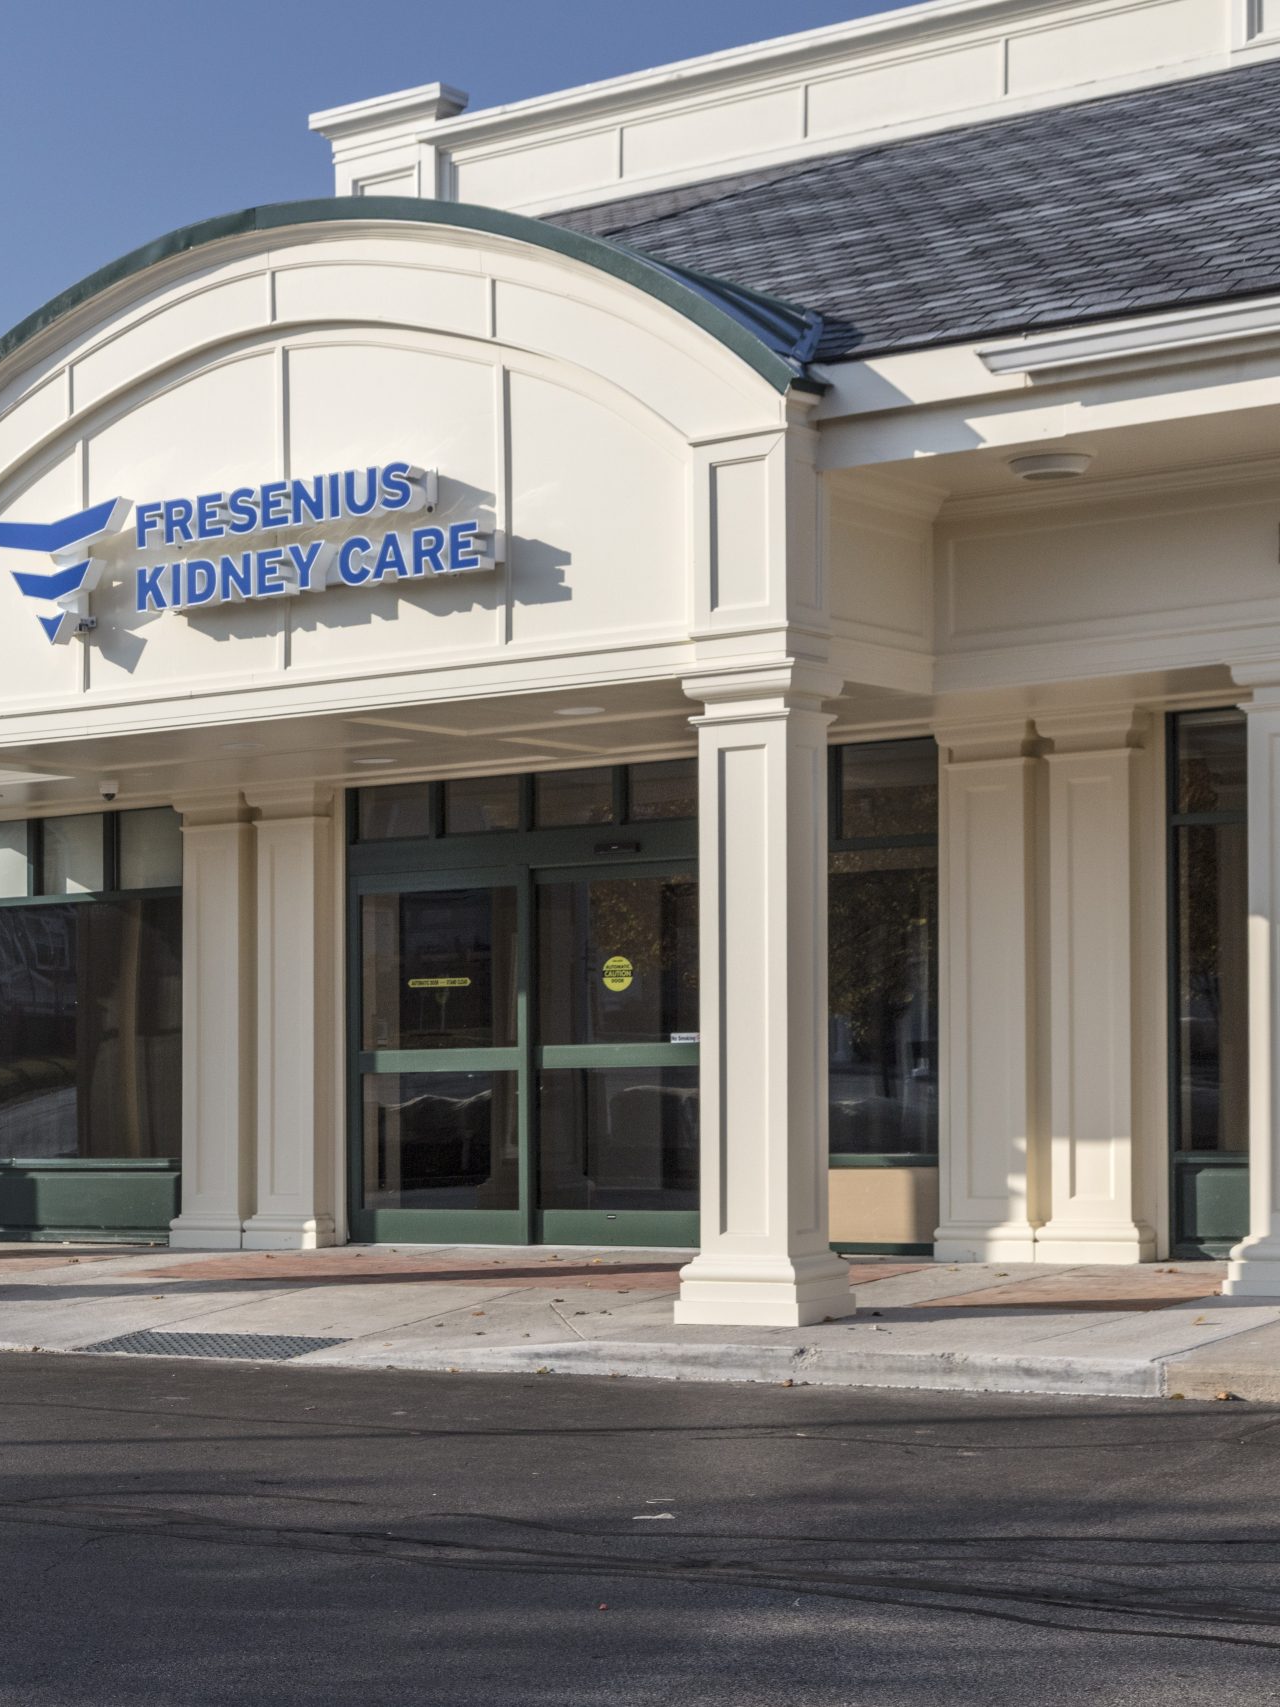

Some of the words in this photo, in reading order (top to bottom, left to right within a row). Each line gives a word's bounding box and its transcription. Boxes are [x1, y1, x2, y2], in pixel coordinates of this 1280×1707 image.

[136, 460, 412, 549] FRESENIUS
[136, 540, 324, 612] KIDNEY
[338, 519, 481, 586] CARE
